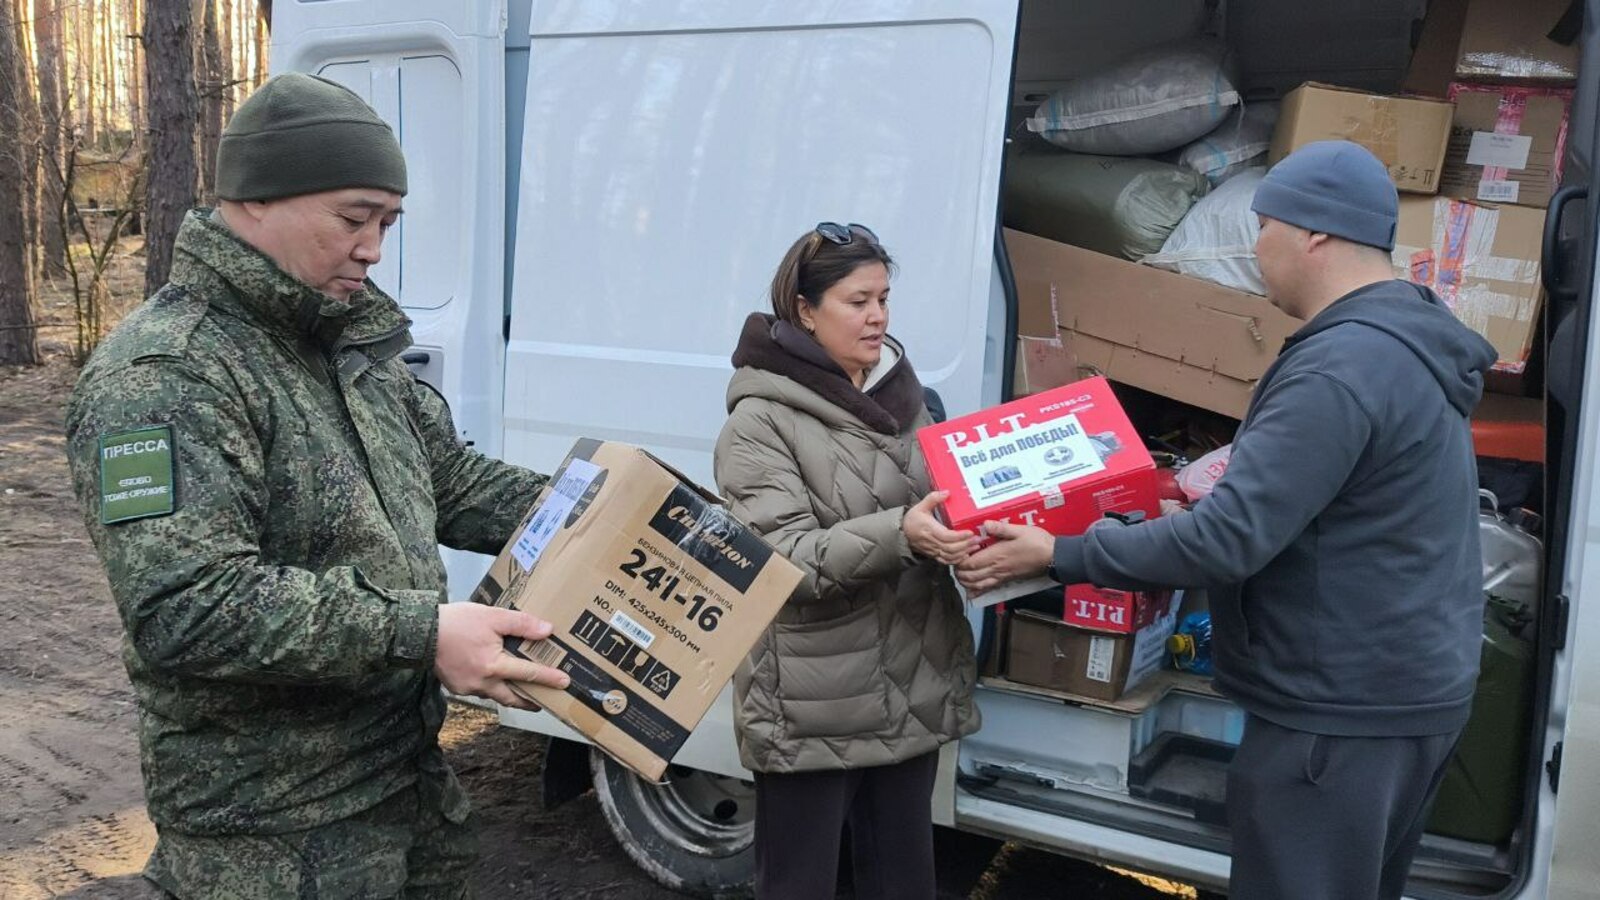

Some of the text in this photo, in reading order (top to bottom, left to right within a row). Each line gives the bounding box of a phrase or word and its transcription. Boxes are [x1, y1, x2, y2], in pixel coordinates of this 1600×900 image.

[103, 438, 169, 460] ПРЕССА
[960, 423, 1080, 469] Всё для ПОБЕДЫ!
[637, 537, 734, 613] БЕНЗИНОВАЯ ЦЕПНАЯ ПИЛА
[604, 579, 627, 600] DIM:
[618, 548, 724, 632] 241-16
[593, 594, 615, 615] NO.:
[1071, 598, 1126, 625] P.I.T.
